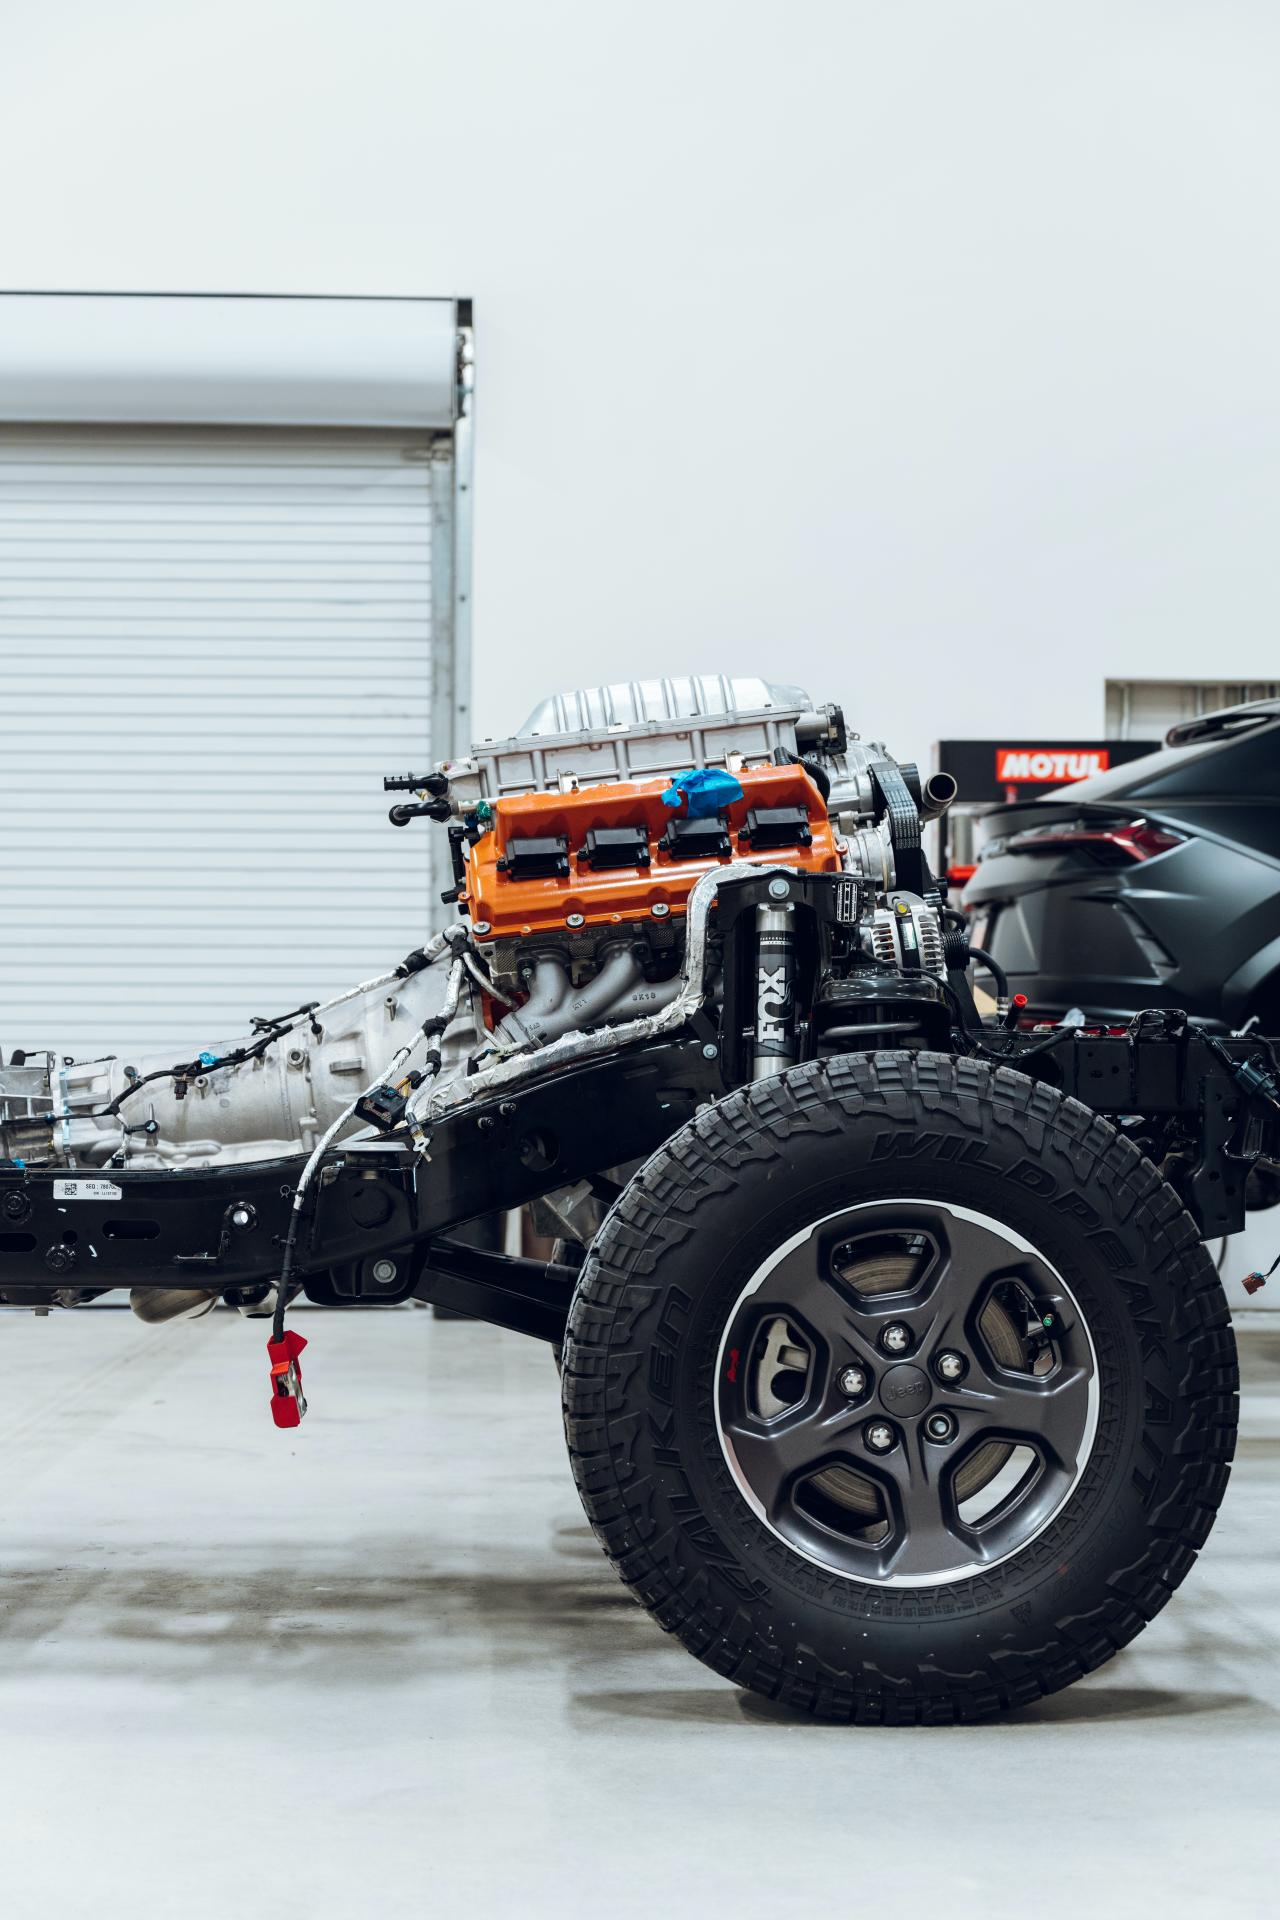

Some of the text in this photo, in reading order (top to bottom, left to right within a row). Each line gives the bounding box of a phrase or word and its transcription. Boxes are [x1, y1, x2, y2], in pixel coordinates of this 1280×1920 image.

[1002, 754, 1103, 779] MOTUL
[757, 967, 788, 1043] FOX
[868, 1129, 1169, 1367] WILDPEAK
[887, 1381, 924, 1400] Jeep
[646, 1283, 773, 1607] FALKEN
